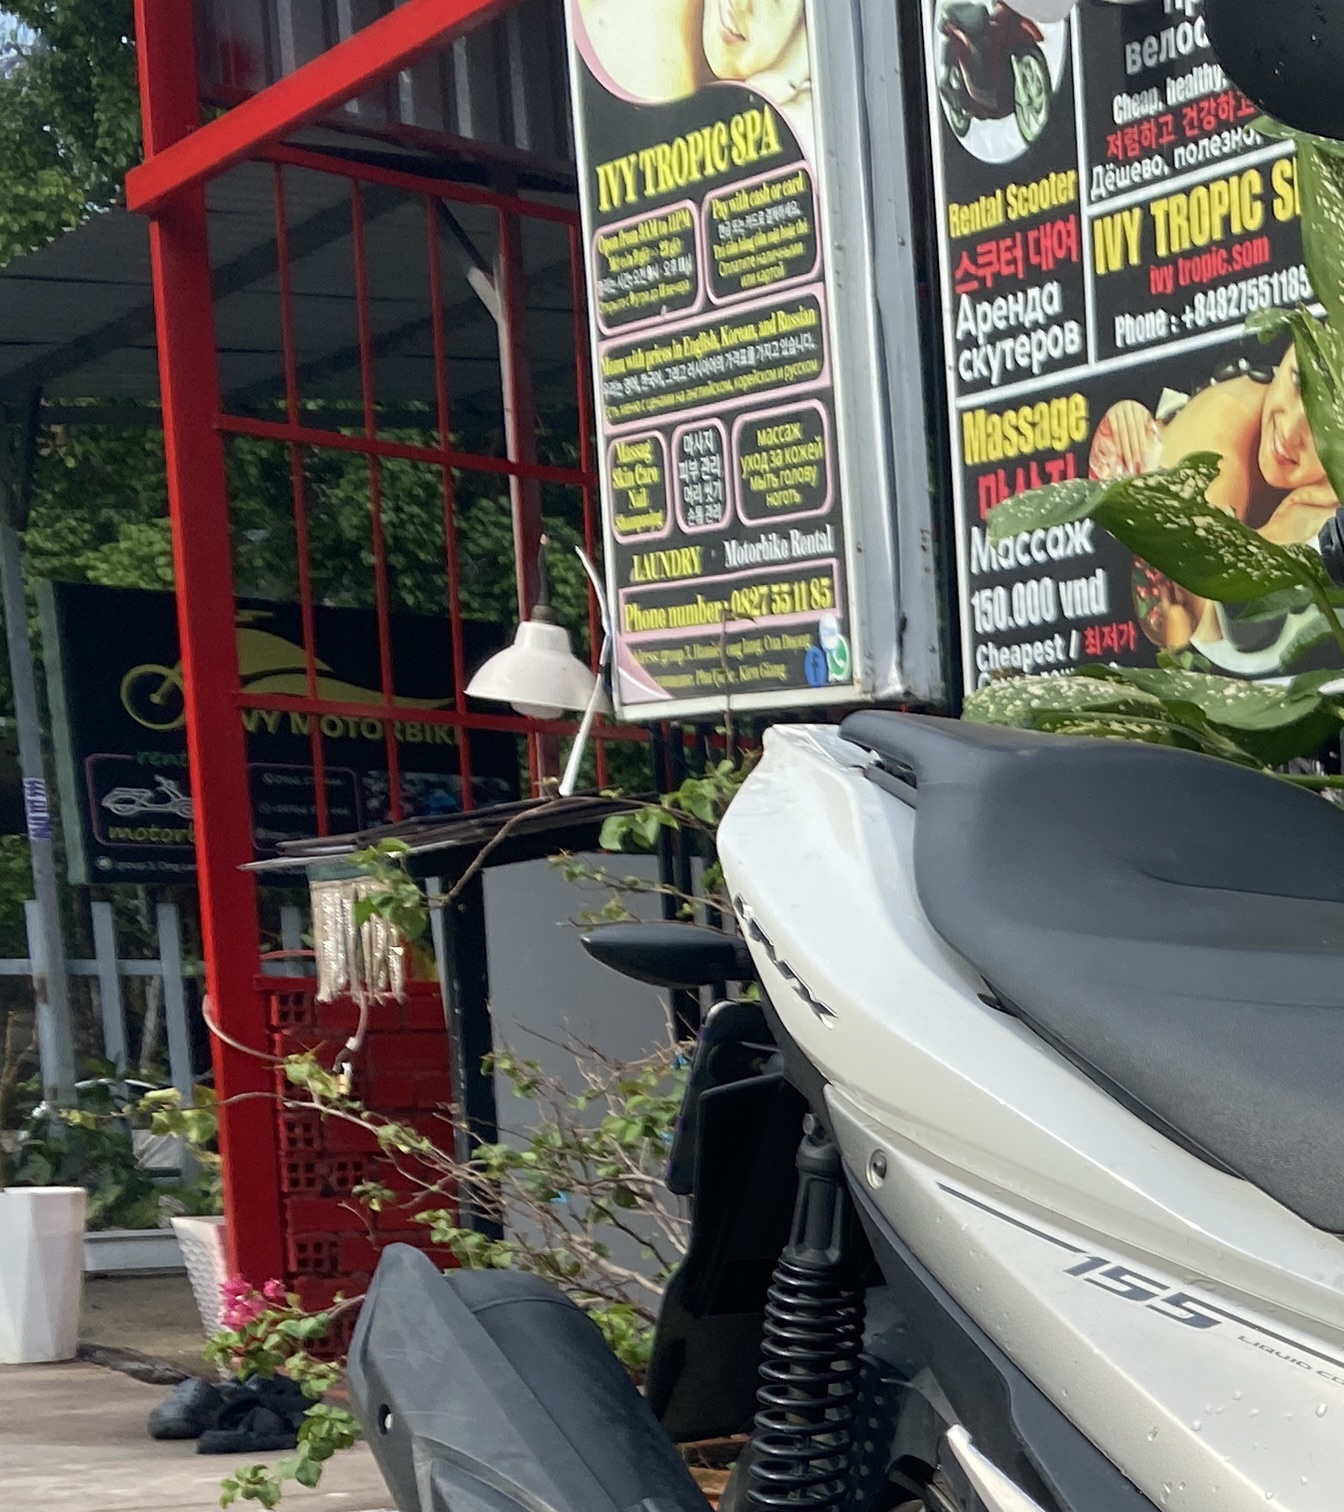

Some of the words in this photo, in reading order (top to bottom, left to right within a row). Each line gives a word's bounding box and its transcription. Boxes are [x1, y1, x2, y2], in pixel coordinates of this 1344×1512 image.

[595, 153, 638, 212] IVY
[639, 121, 730, 197] TROPIC
[730, 104, 782, 166] SPA
[948, 188, 1006, 238] Rental
[1006, 169, 1078, 221] Scooter
[1093, 207, 1143, 275] IVY
[1150, 169, 1264, 258] TROPIC
[955, 231, 1026, 295] 스쿠터
[1027, 214, 1080, 271] 대여
[956, 281, 1064, 346] Аренда
[1114, 308, 1168, 348] Phone
[959, 320, 1082, 386] скутеров
[683, 429, 716, 456] 마사지
[769, 448, 782, 468] за
[784, 435, 824, 464] кожей
[963, 393, 1089, 467] Massage
[678, 458, 700, 483] 피부
[631, 546, 703, 582] LAUNDRY
[723, 532, 789, 568] Motorbike
[789, 524, 835, 557] Rental
[624, 602, 666, 633] Phone
[731, 586, 768, 617] 0827
[771, 583, 791, 614] 55
[793, 580, 809, 612] 11
[810, 577, 832, 610] 85
[971, 576, 1059, 635] 150.000
[1059, 568, 1109, 620] vnd
[976, 632, 1067, 674] Cheapest
[1062, 1255, 1223, 1330] 155
[1237, 1335, 1312, 1371] LIQUID
